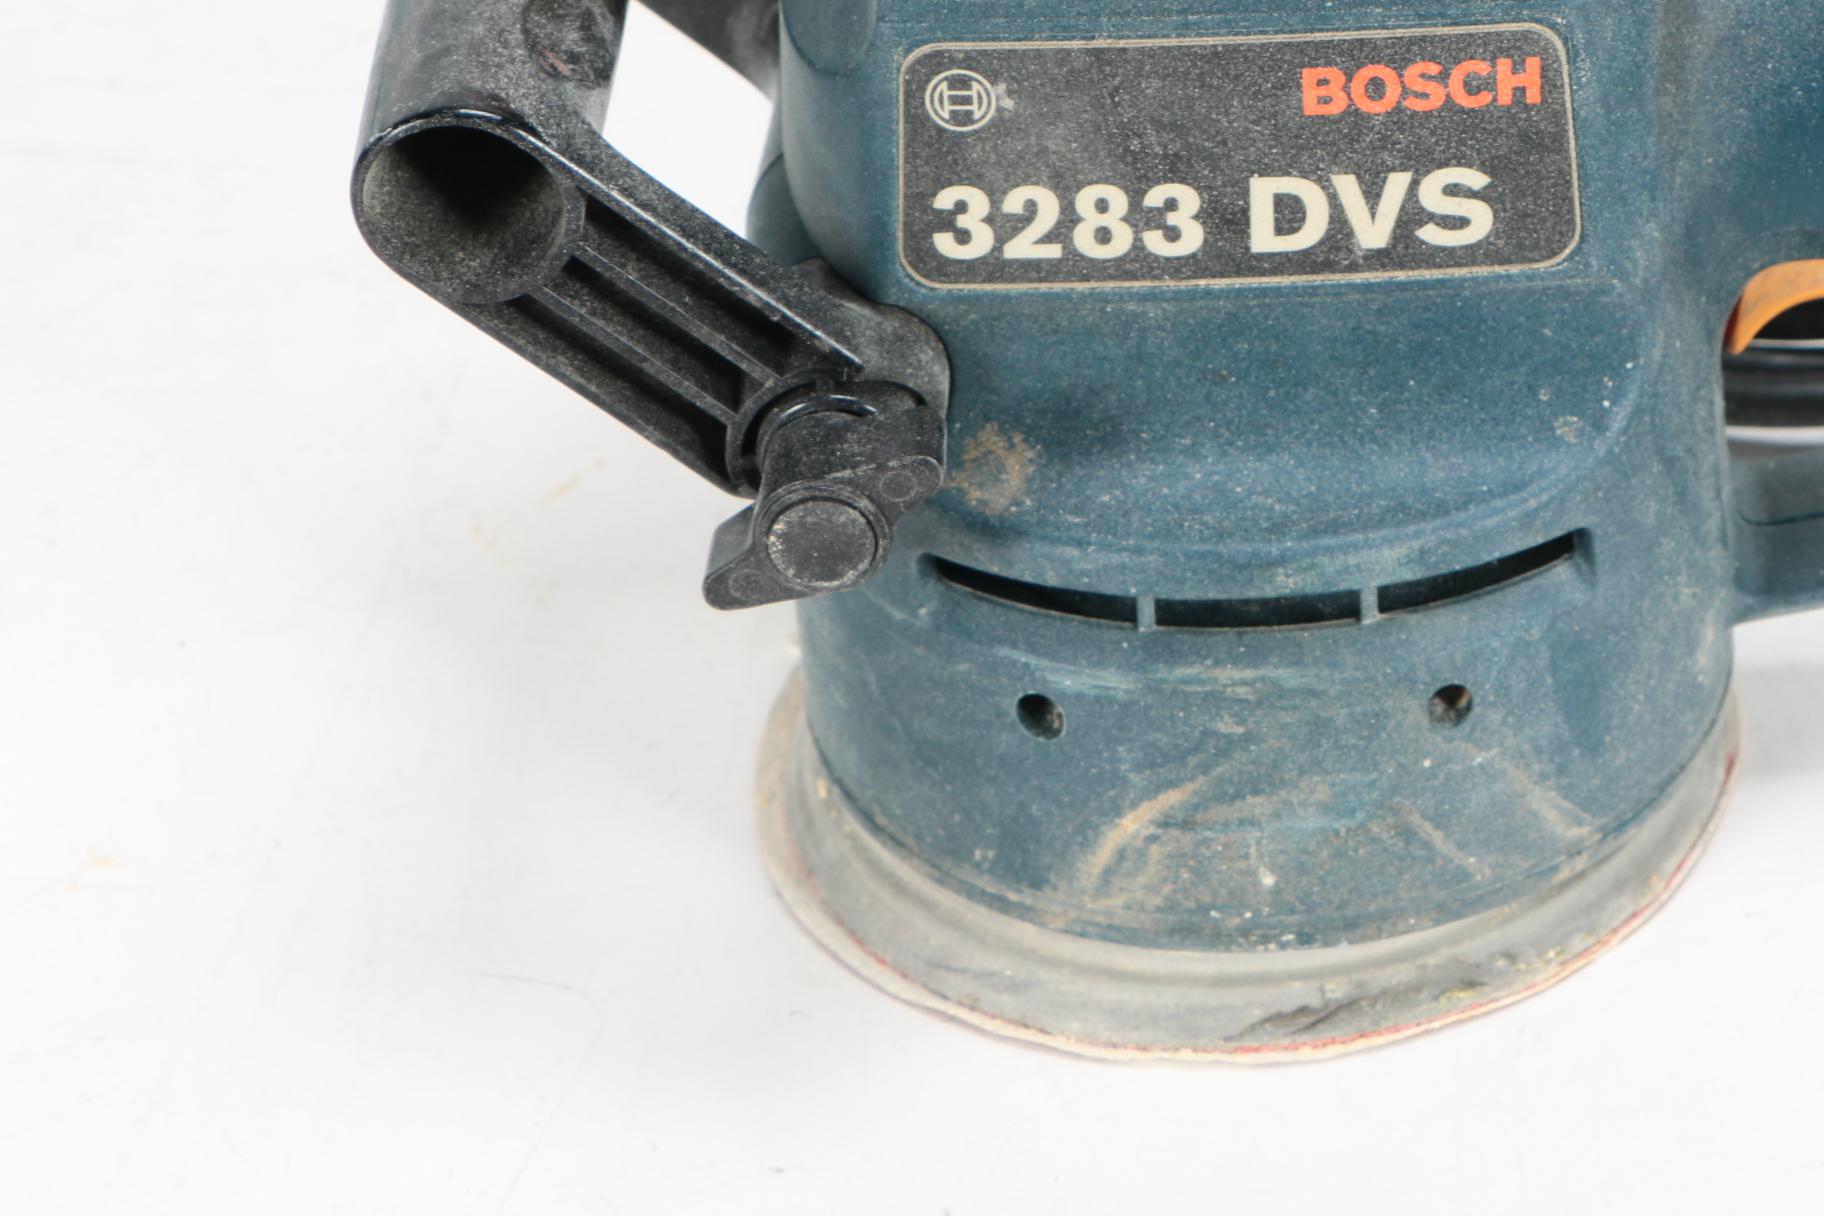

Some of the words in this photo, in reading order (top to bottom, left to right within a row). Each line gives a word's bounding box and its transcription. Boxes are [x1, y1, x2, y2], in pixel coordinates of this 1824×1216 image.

[1301, 56, 1542, 116] BOSCH
[931, 183, 1205, 260] 3283
[1248, 166, 1494, 254] DVS
